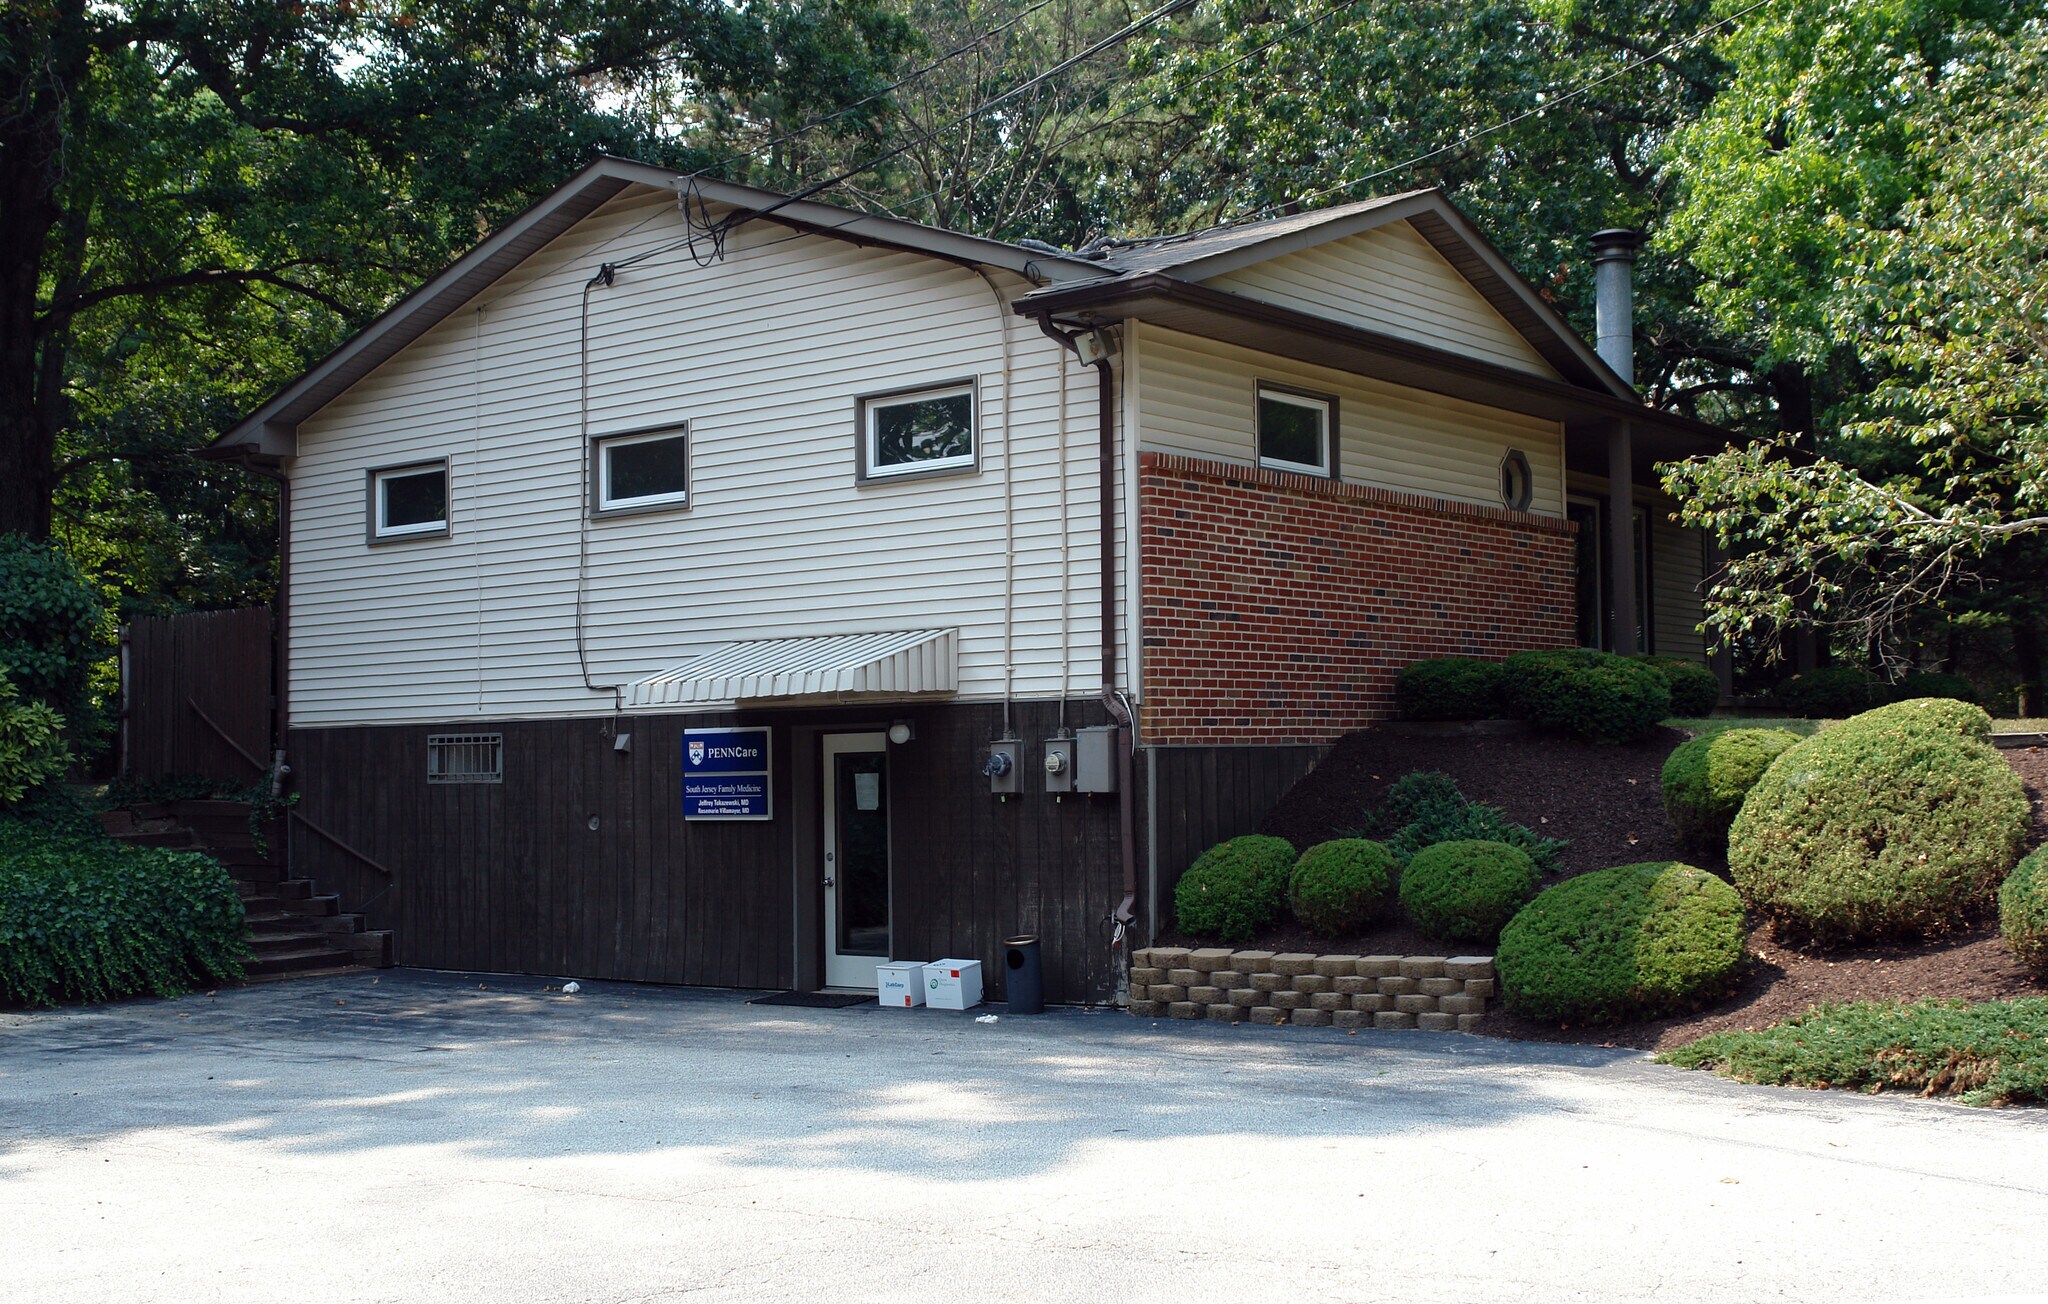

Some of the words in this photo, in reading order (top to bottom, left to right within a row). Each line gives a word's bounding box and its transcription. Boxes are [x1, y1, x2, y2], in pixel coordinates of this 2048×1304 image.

[708, 747, 758, 758] PENNCare
[686, 785, 701, 793] South
[702, 785, 717, 794] Jersey
[718, 785, 736, 794] Family
[737, 784, 761, 792] Medicine
[698, 799, 713, 807] Jeffrey
